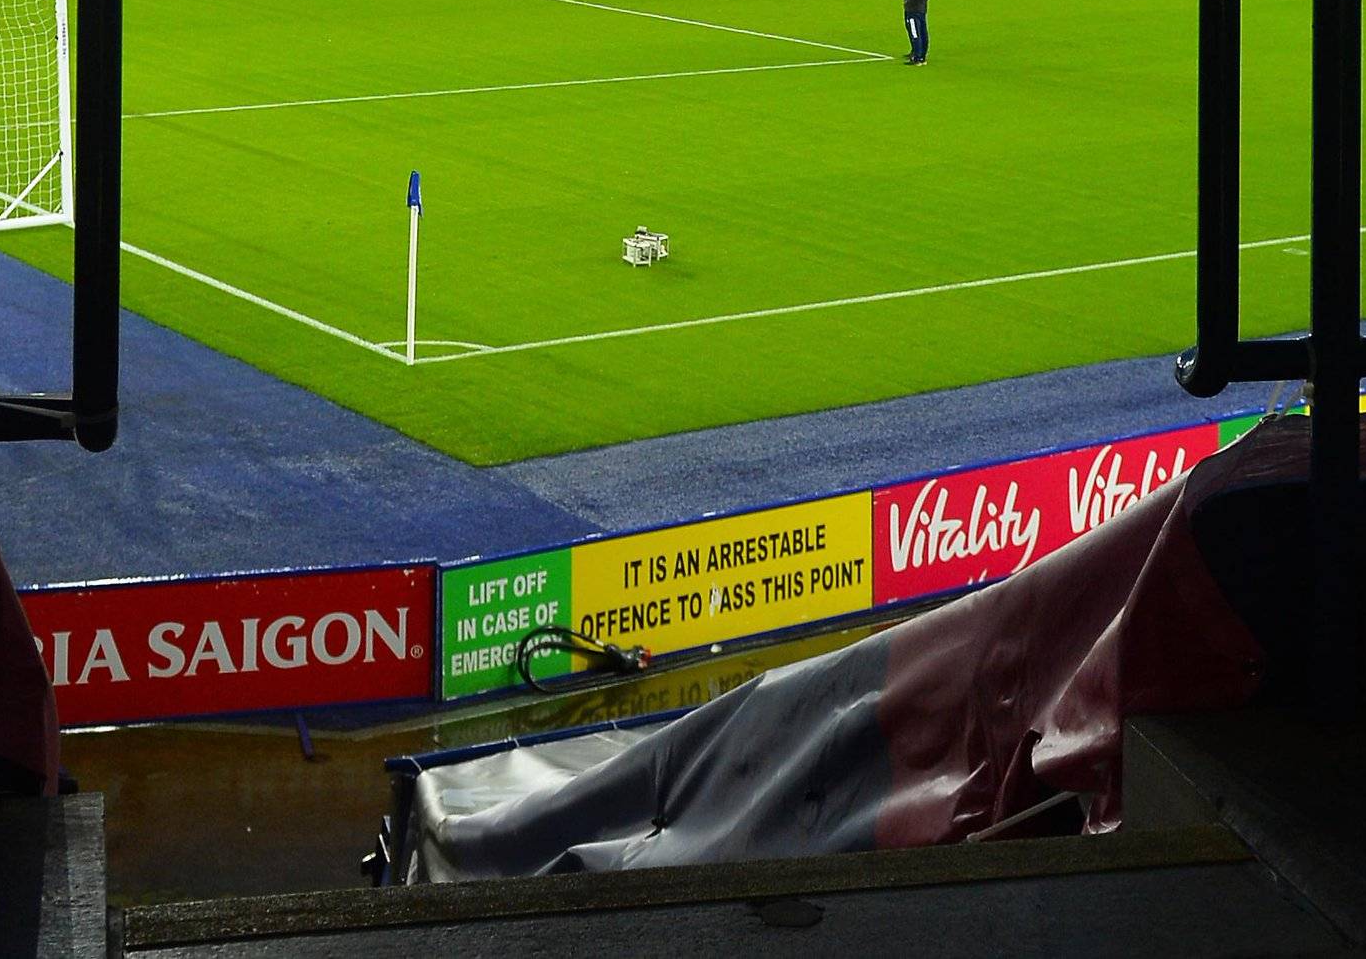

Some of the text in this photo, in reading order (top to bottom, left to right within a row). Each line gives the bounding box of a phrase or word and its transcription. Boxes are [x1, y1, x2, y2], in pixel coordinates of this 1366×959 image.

[624, 525, 826, 589] IT IS AN ARRESTABLE
[889, 478, 1040, 575] Vitality
[457, 601, 559, 642] IN CASE OF
[468, 570, 547, 607] LIFT OFF
[580, 598, 670, 639] OFFENCE
[677, 592, 702, 623] TO
[762, 571, 804, 604] THIS
[810, 559, 865, 594] POINT
[148, 607, 410, 680] SAIGON
